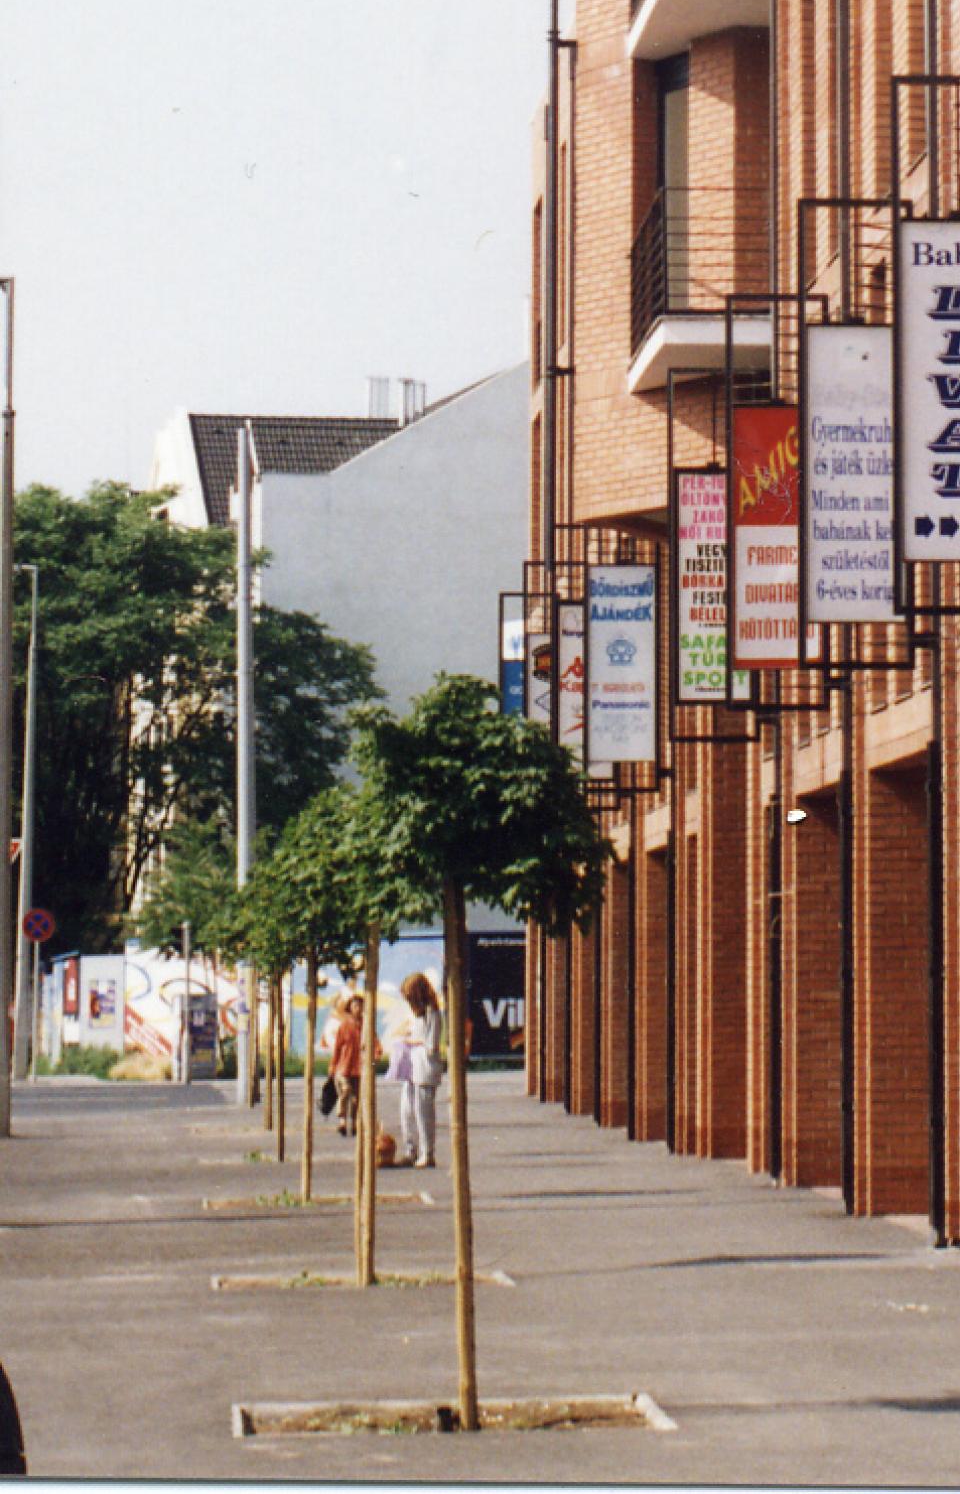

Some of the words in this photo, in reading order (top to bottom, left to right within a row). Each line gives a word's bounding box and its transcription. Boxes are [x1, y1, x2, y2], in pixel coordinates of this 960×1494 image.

[811, 489, 861, 512] Minden
[863, 490, 889, 512] ami
[682, 670, 747, 687] SPOT
